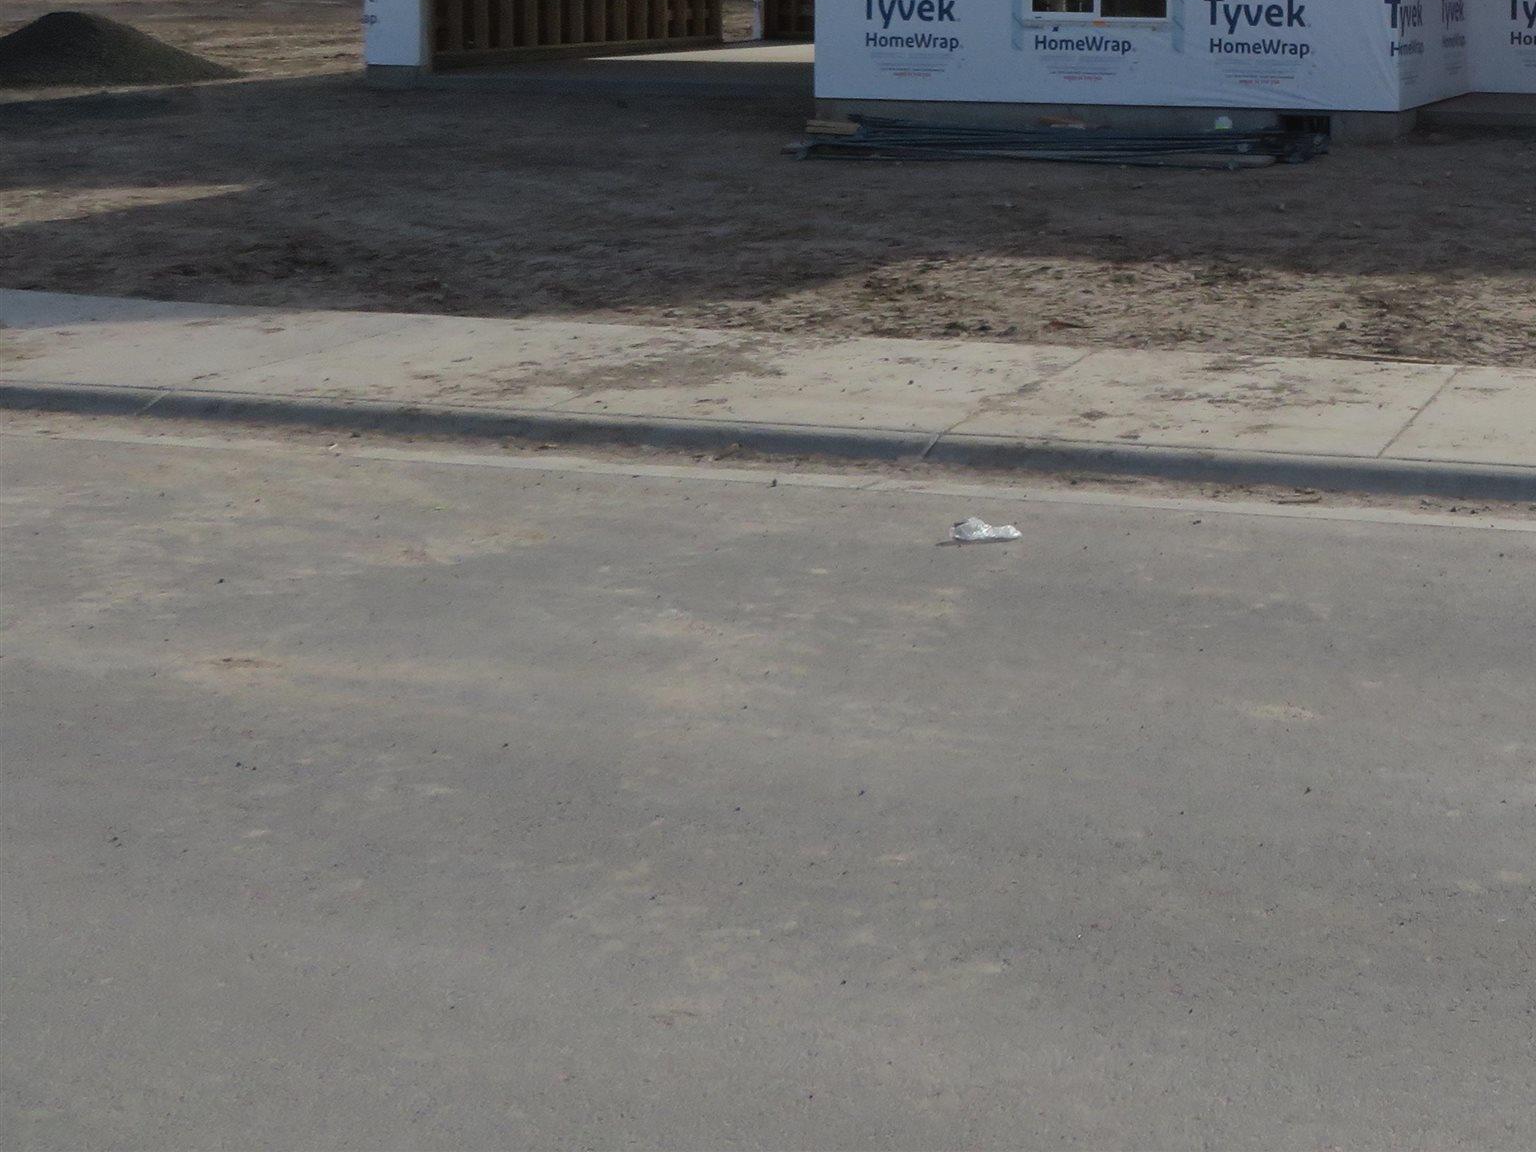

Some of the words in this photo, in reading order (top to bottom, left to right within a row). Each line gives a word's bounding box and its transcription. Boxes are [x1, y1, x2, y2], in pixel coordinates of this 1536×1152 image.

[865, 32, 960, 52] HomeWrap
[1034, 35, 1132, 54] HomeWrap
[1209, 38, 1310, 58] HomeWrap
